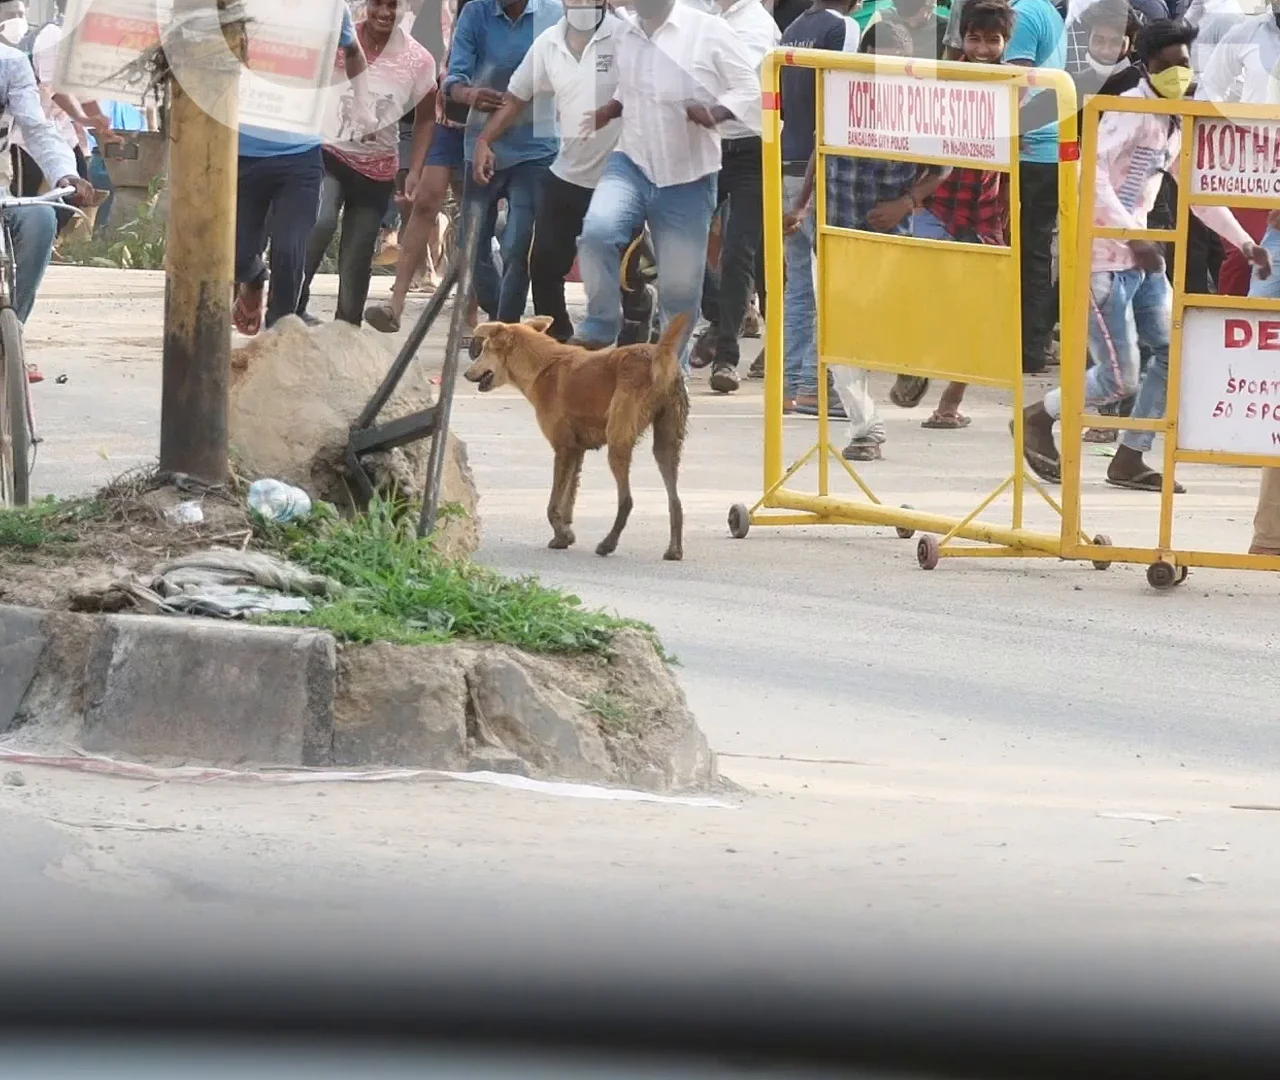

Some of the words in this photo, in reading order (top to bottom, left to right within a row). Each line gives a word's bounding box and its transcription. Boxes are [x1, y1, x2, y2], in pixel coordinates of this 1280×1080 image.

[848, 81, 906, 132] KOTHANUR
[907, 85, 949, 136] POLICE
[949, 89, 996, 140] STATION
[848, 131, 878, 148] BANGALORE
[878, 135, 890, 150] CITY
[890, 135, 910, 151] POLICE
[1200, 175, 1271, 194] BENGALURU
[1211, 400, 1234, 419] 50
